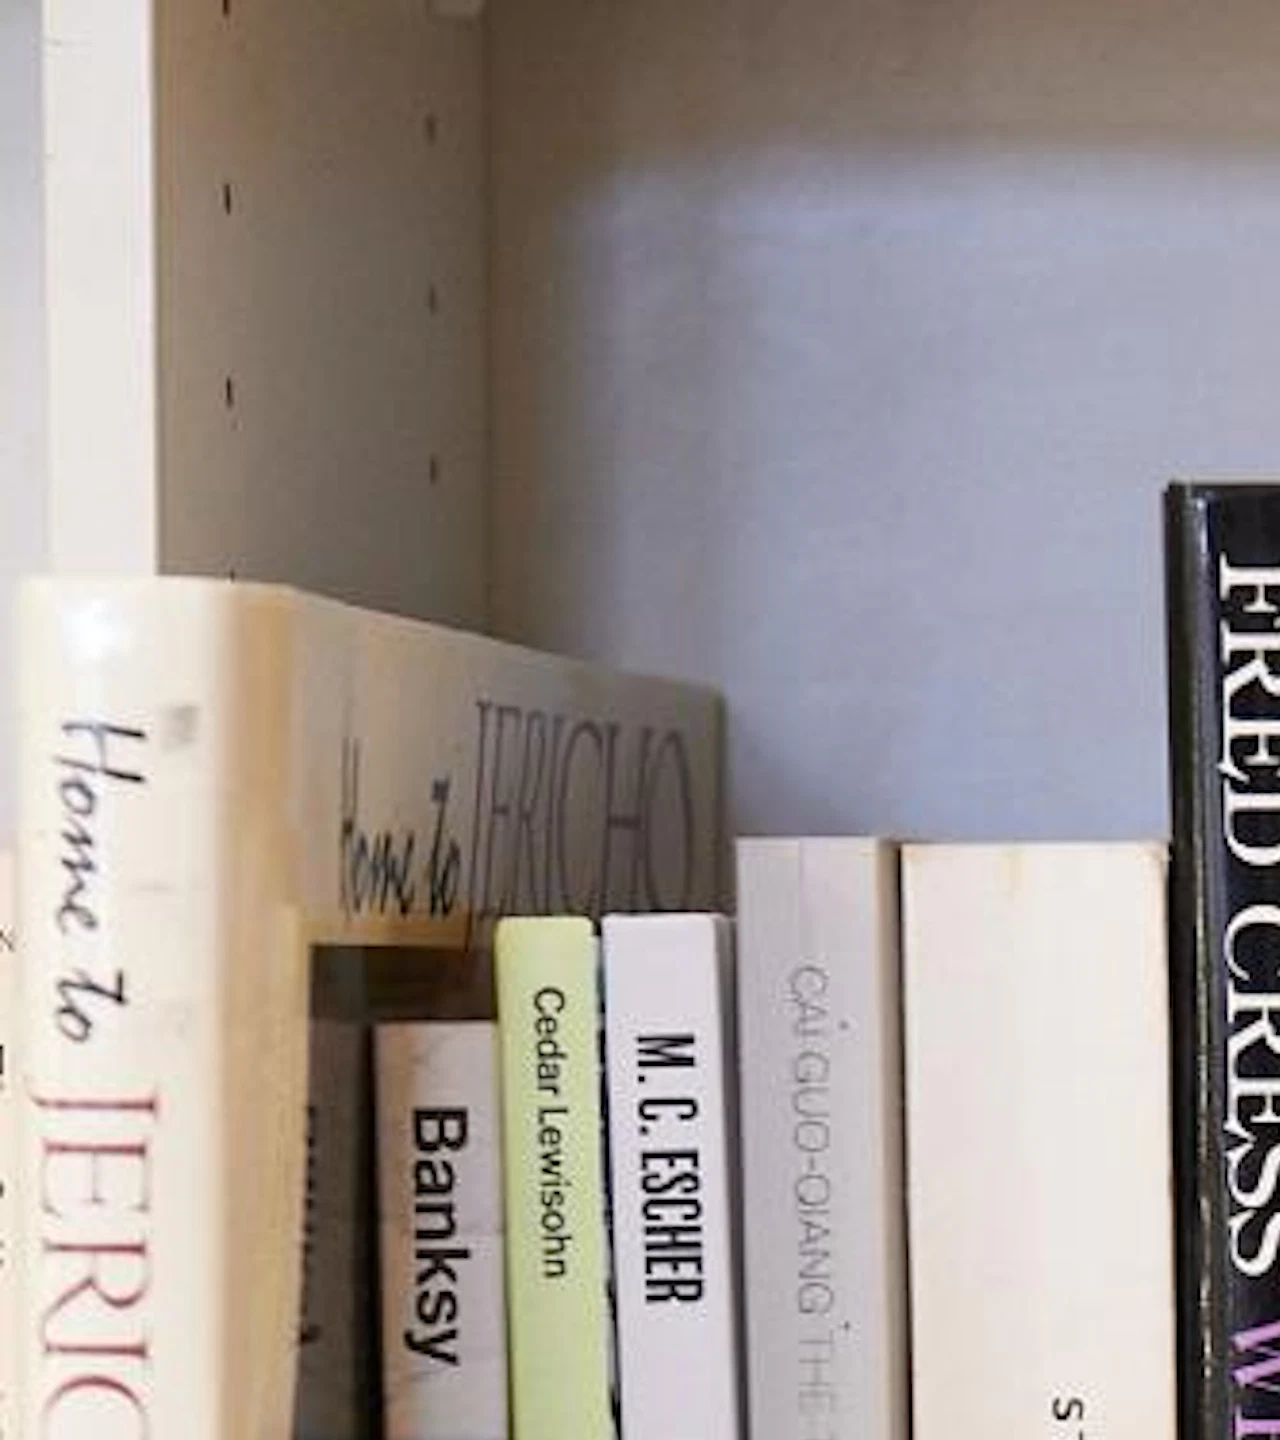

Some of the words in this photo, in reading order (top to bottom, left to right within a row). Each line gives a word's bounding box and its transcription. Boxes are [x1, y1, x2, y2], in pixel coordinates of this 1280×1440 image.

[53, 720, 148, 938] Home
[54, 969, 129, 1045] to
[533, 986, 570, 1096] Cedar
[793, 965, 833, 1038] CAI
[637, 1033, 697, 1084] M.
[638, 1098, 700, 1135] C.
[404, 1106, 470, 1367] Banksy
[538, 1107, 572, 1278] Lewisohn
[641, 1150, 704, 1304] ESCHER
[799, 1334, 838, 1411] THE
